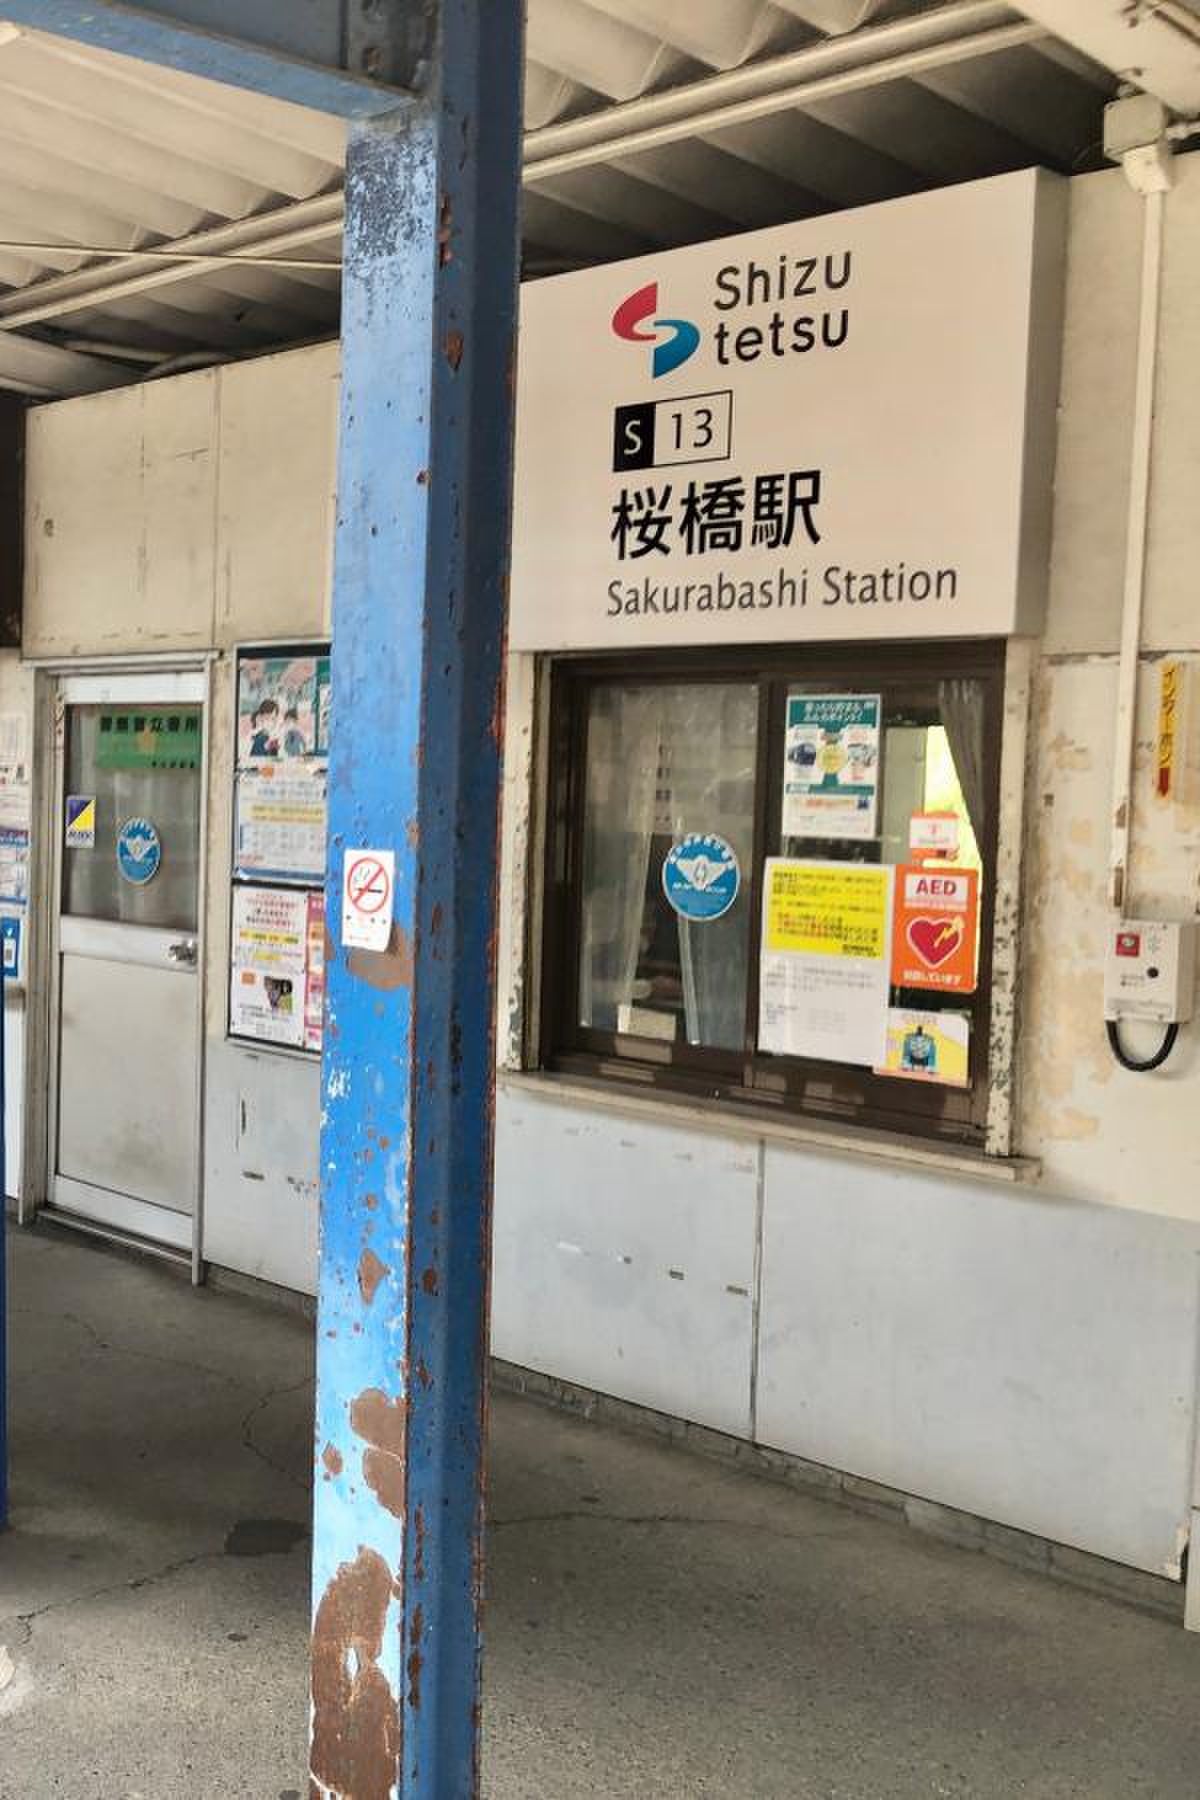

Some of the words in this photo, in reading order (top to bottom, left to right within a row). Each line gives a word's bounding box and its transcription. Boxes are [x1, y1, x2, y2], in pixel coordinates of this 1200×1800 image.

[714, 250, 852, 311] Shizu
[714, 309, 850, 365] tetsu
[623, 419, 642, 456] S
[671, 408, 713, 450] 13
[611, 469, 822, 561] 桜橋駅
[607, 567, 808, 617] Sakurabashi
[822, 562, 957, 606] Station
[915, 878, 958, 897] AED
